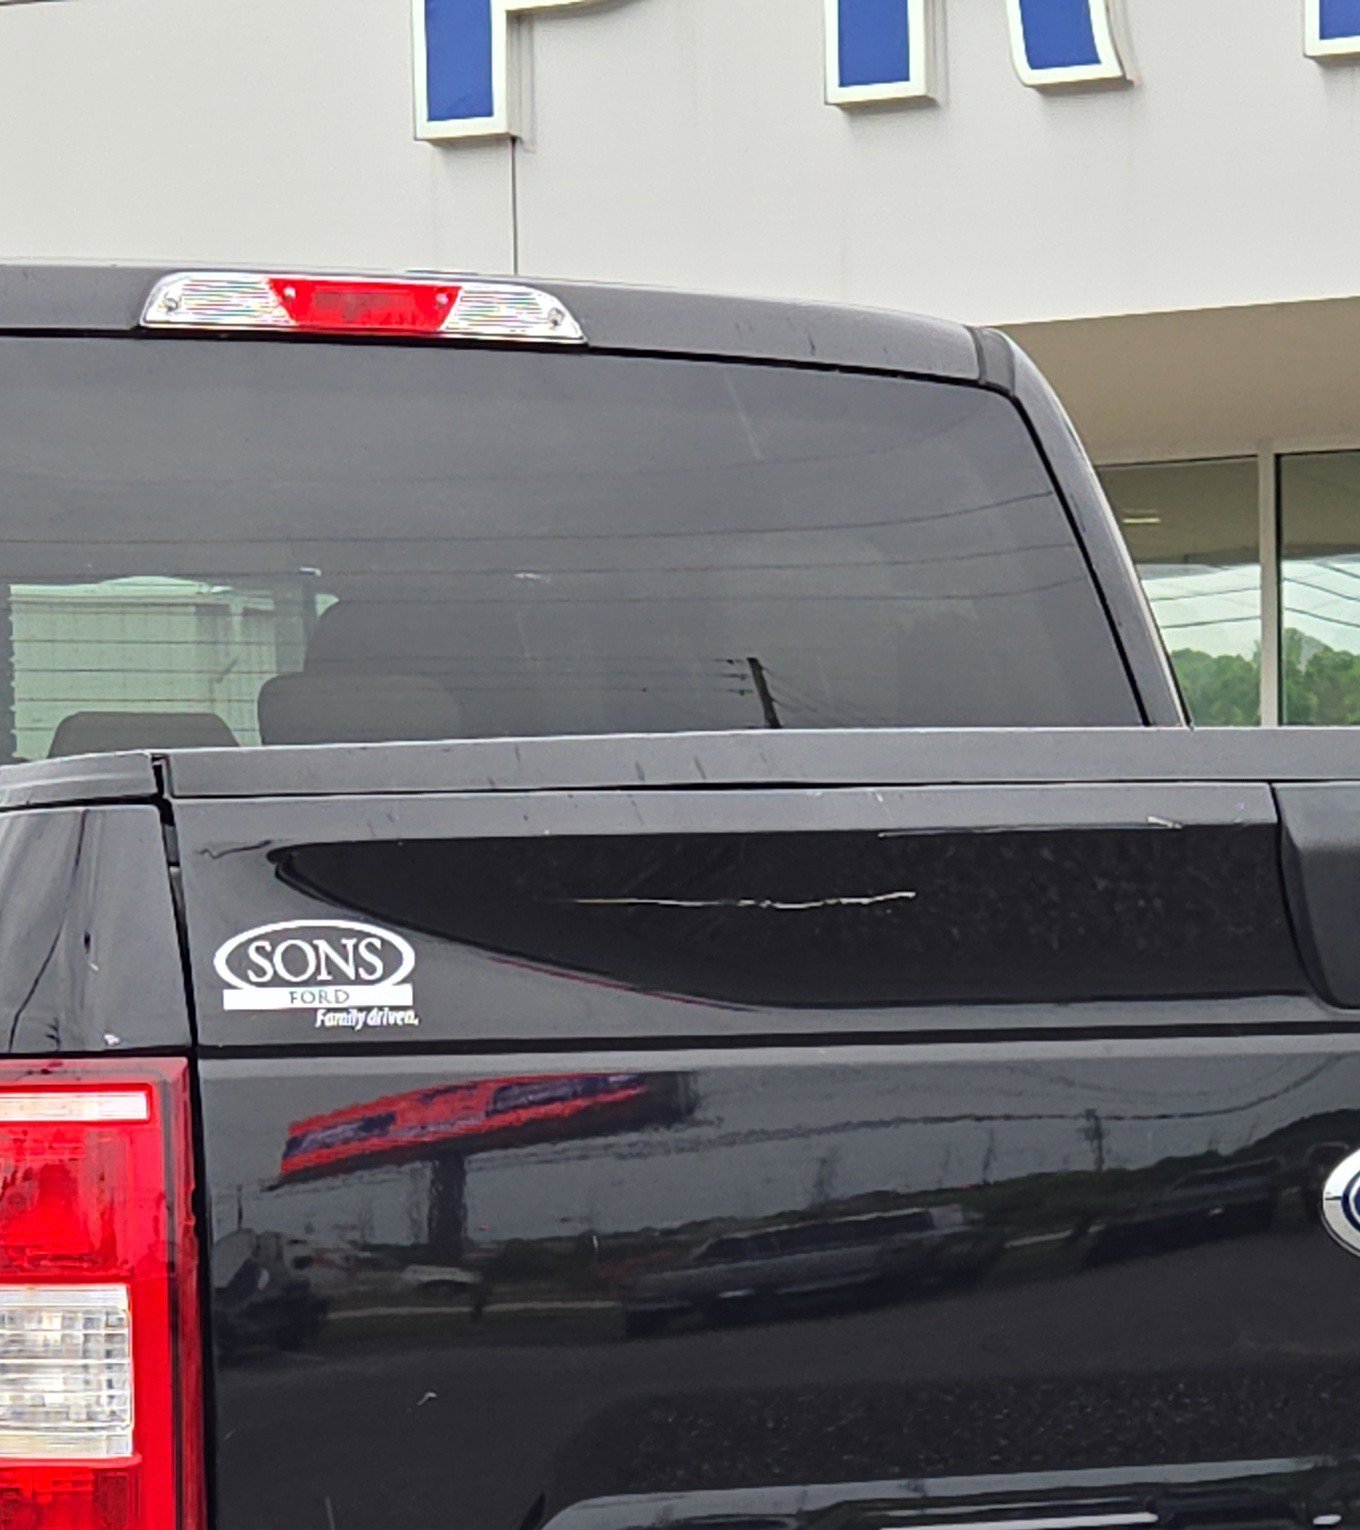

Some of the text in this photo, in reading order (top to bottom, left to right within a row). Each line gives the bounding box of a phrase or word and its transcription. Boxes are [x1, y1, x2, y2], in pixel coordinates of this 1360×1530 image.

[246, 937, 384, 983] SONS
[289, 989, 350, 1004] FORD
[315, 1008, 366, 1031] Family
